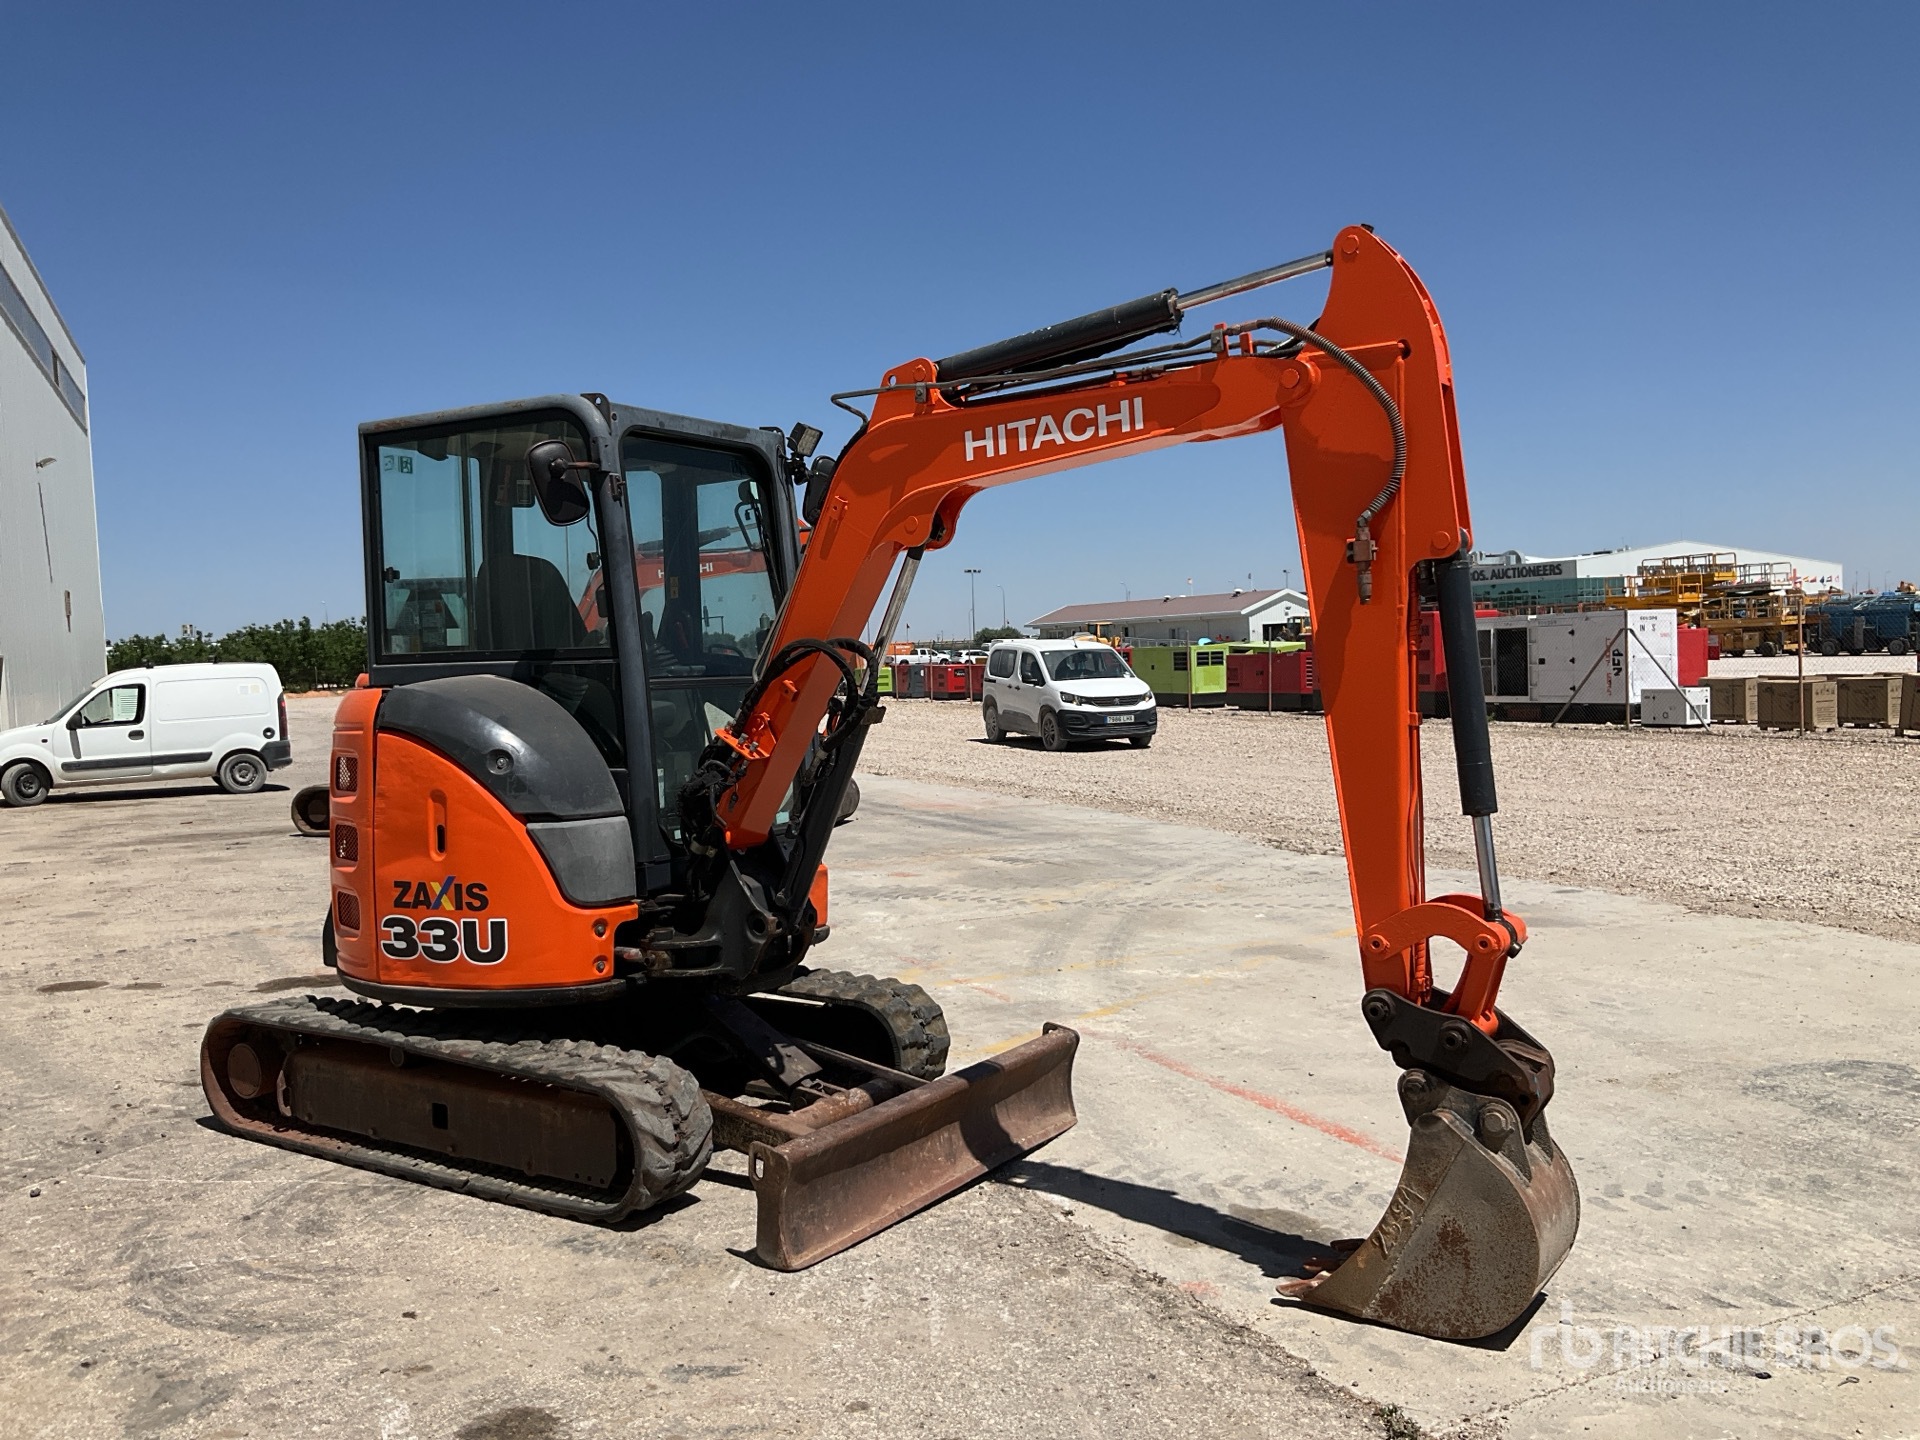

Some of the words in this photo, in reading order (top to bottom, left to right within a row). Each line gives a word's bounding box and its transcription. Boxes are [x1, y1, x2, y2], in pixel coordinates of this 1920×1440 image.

[964, 396, 1144, 461] HITACHI
[1470, 569, 1489, 581] OS.
[1490, 563, 1563, 580] AUCTIONEERS
[393, 876, 489, 912] ZAXIS
[381, 914, 508, 966] 33U
